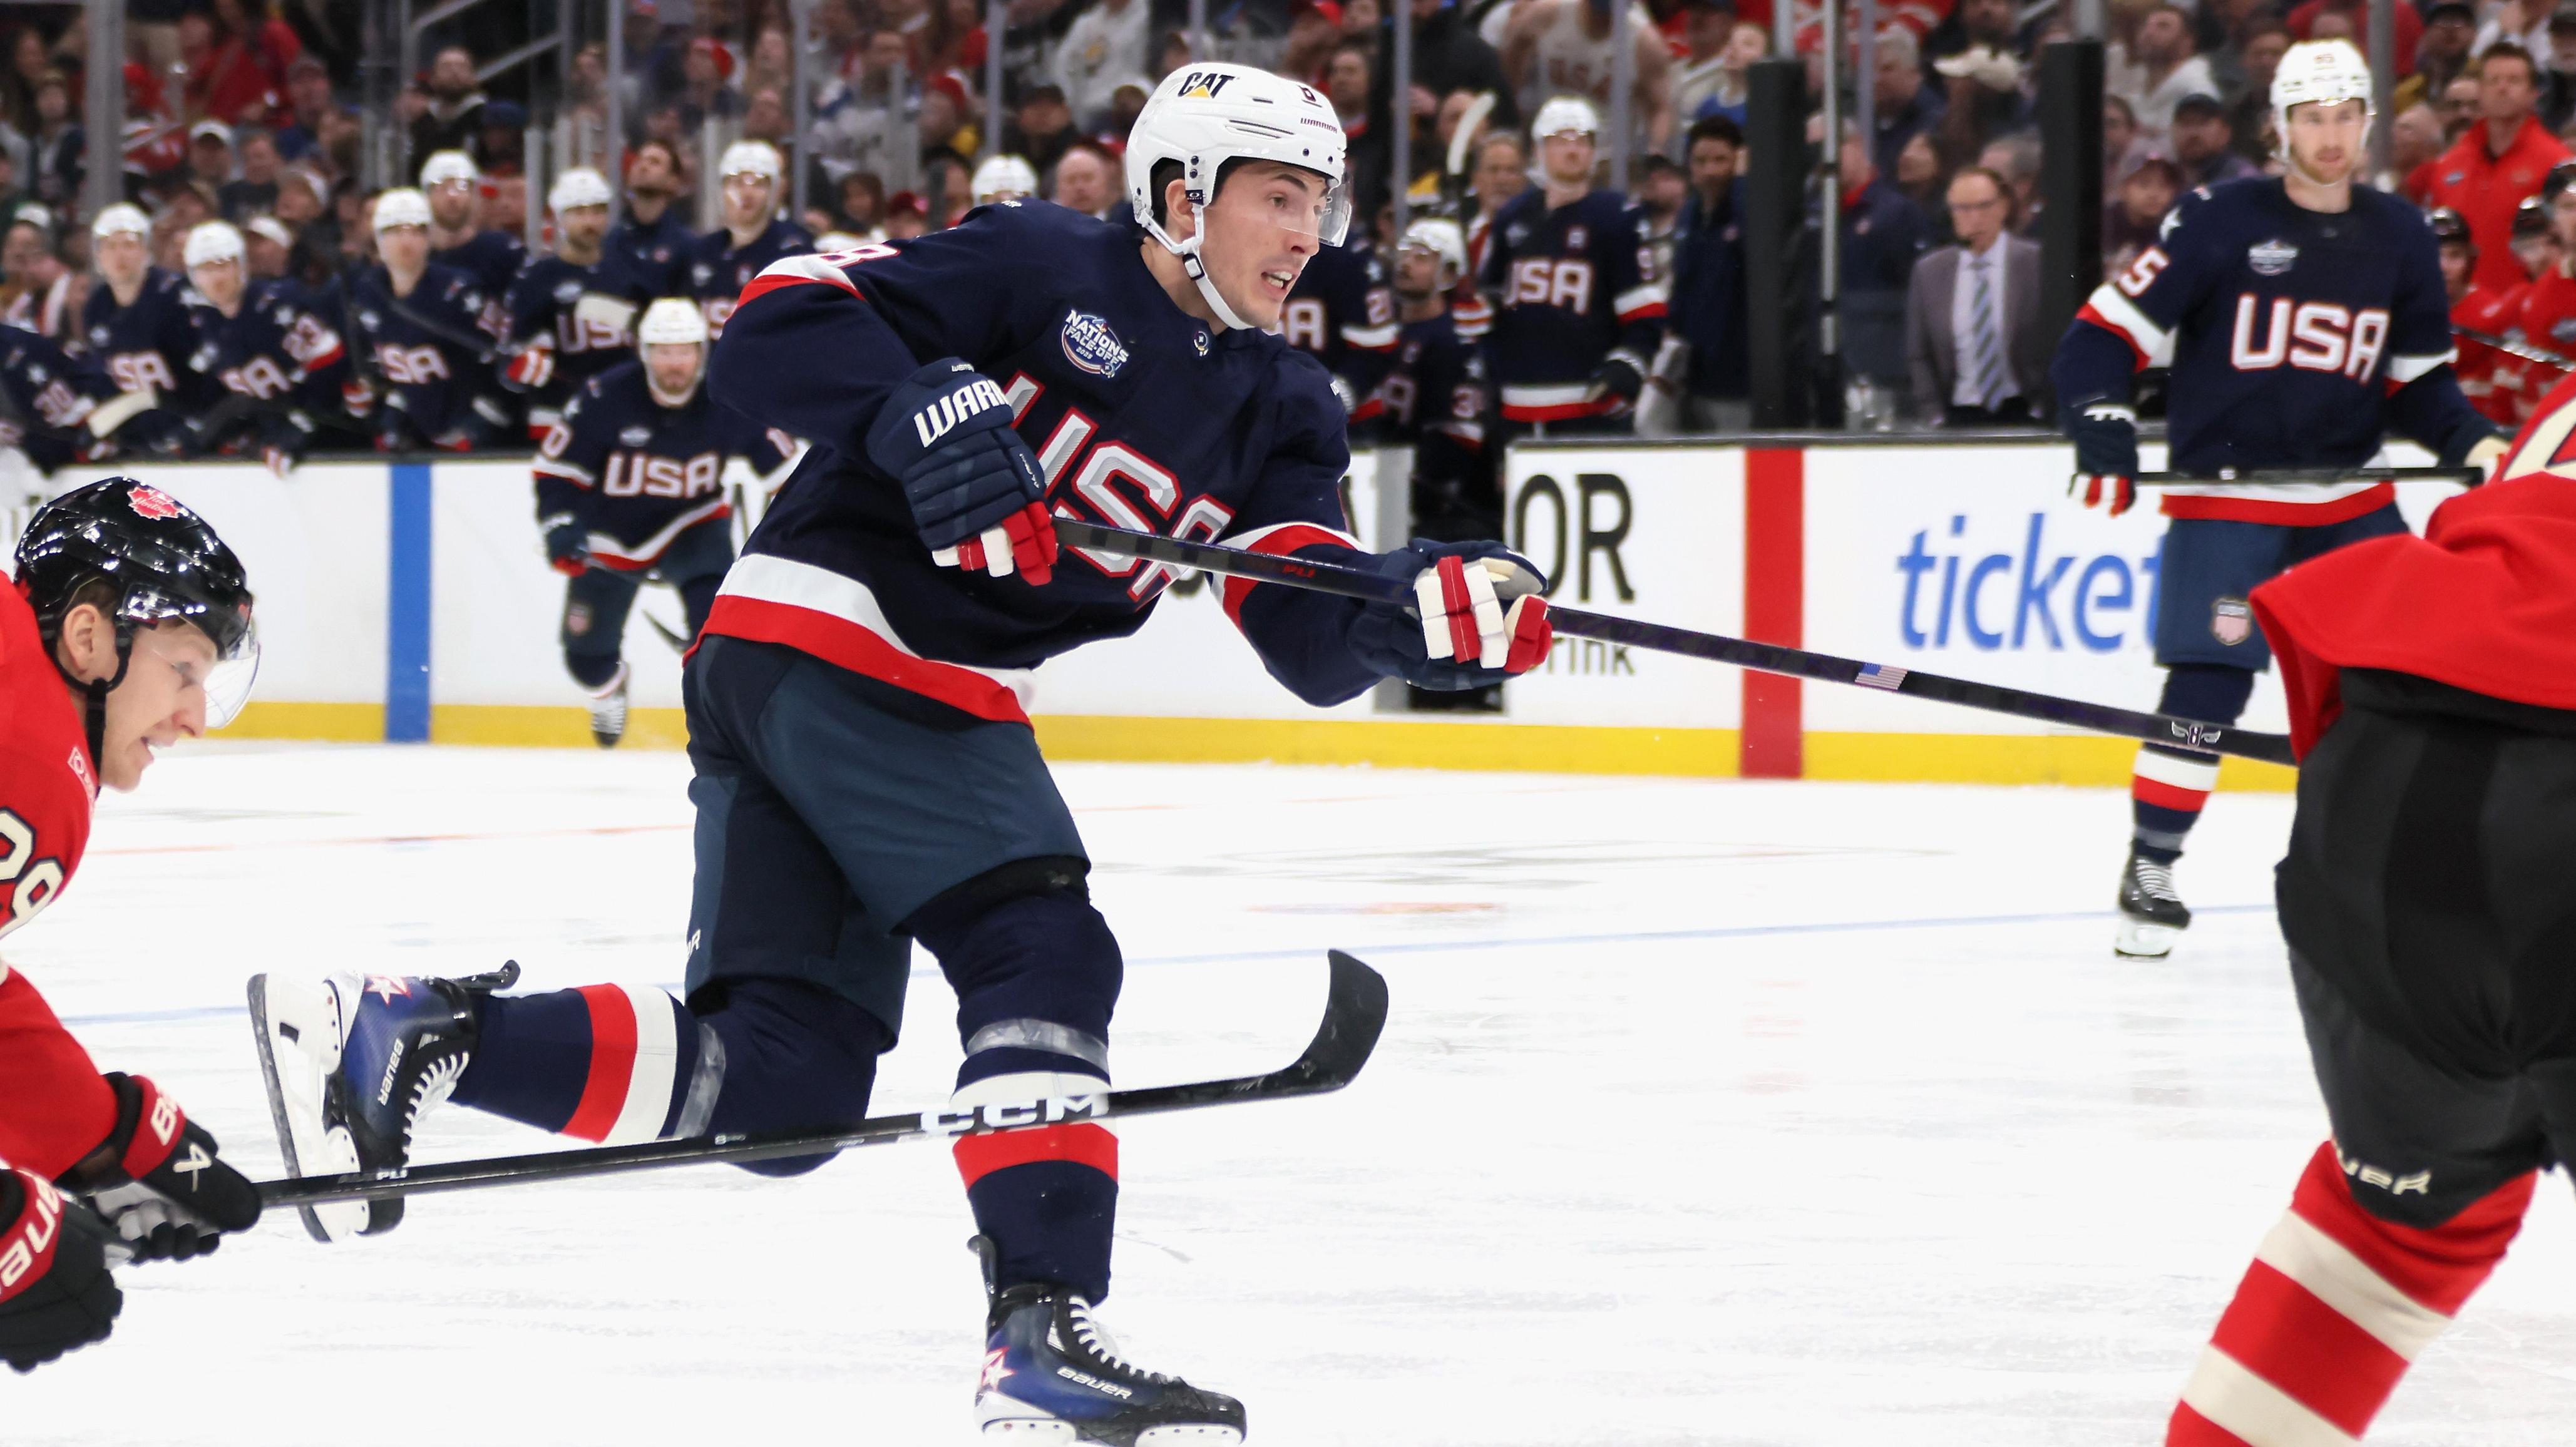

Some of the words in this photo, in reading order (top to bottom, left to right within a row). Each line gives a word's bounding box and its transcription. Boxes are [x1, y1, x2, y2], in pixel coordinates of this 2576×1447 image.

[1178, 72, 1236, 99] CAT
[1300, 117, 1338, 134] WARRIOR
[1065, 309, 1130, 364] NATIONS
[2231, 294, 2390, 385] USA
[105, 350, 178, 402] SA
[220, 355, 291, 401] SA
[603, 452, 720, 499] USA
[1513, 473, 1636, 604] OR
[1895, 512, 2163, 653] ticket
[1529, 637, 1636, 675] rink
[377, 1036, 405, 1107] BAUER
[920, 1095, 1110, 1136] CCM
[1057, 1365, 1133, 1400] BAUER
